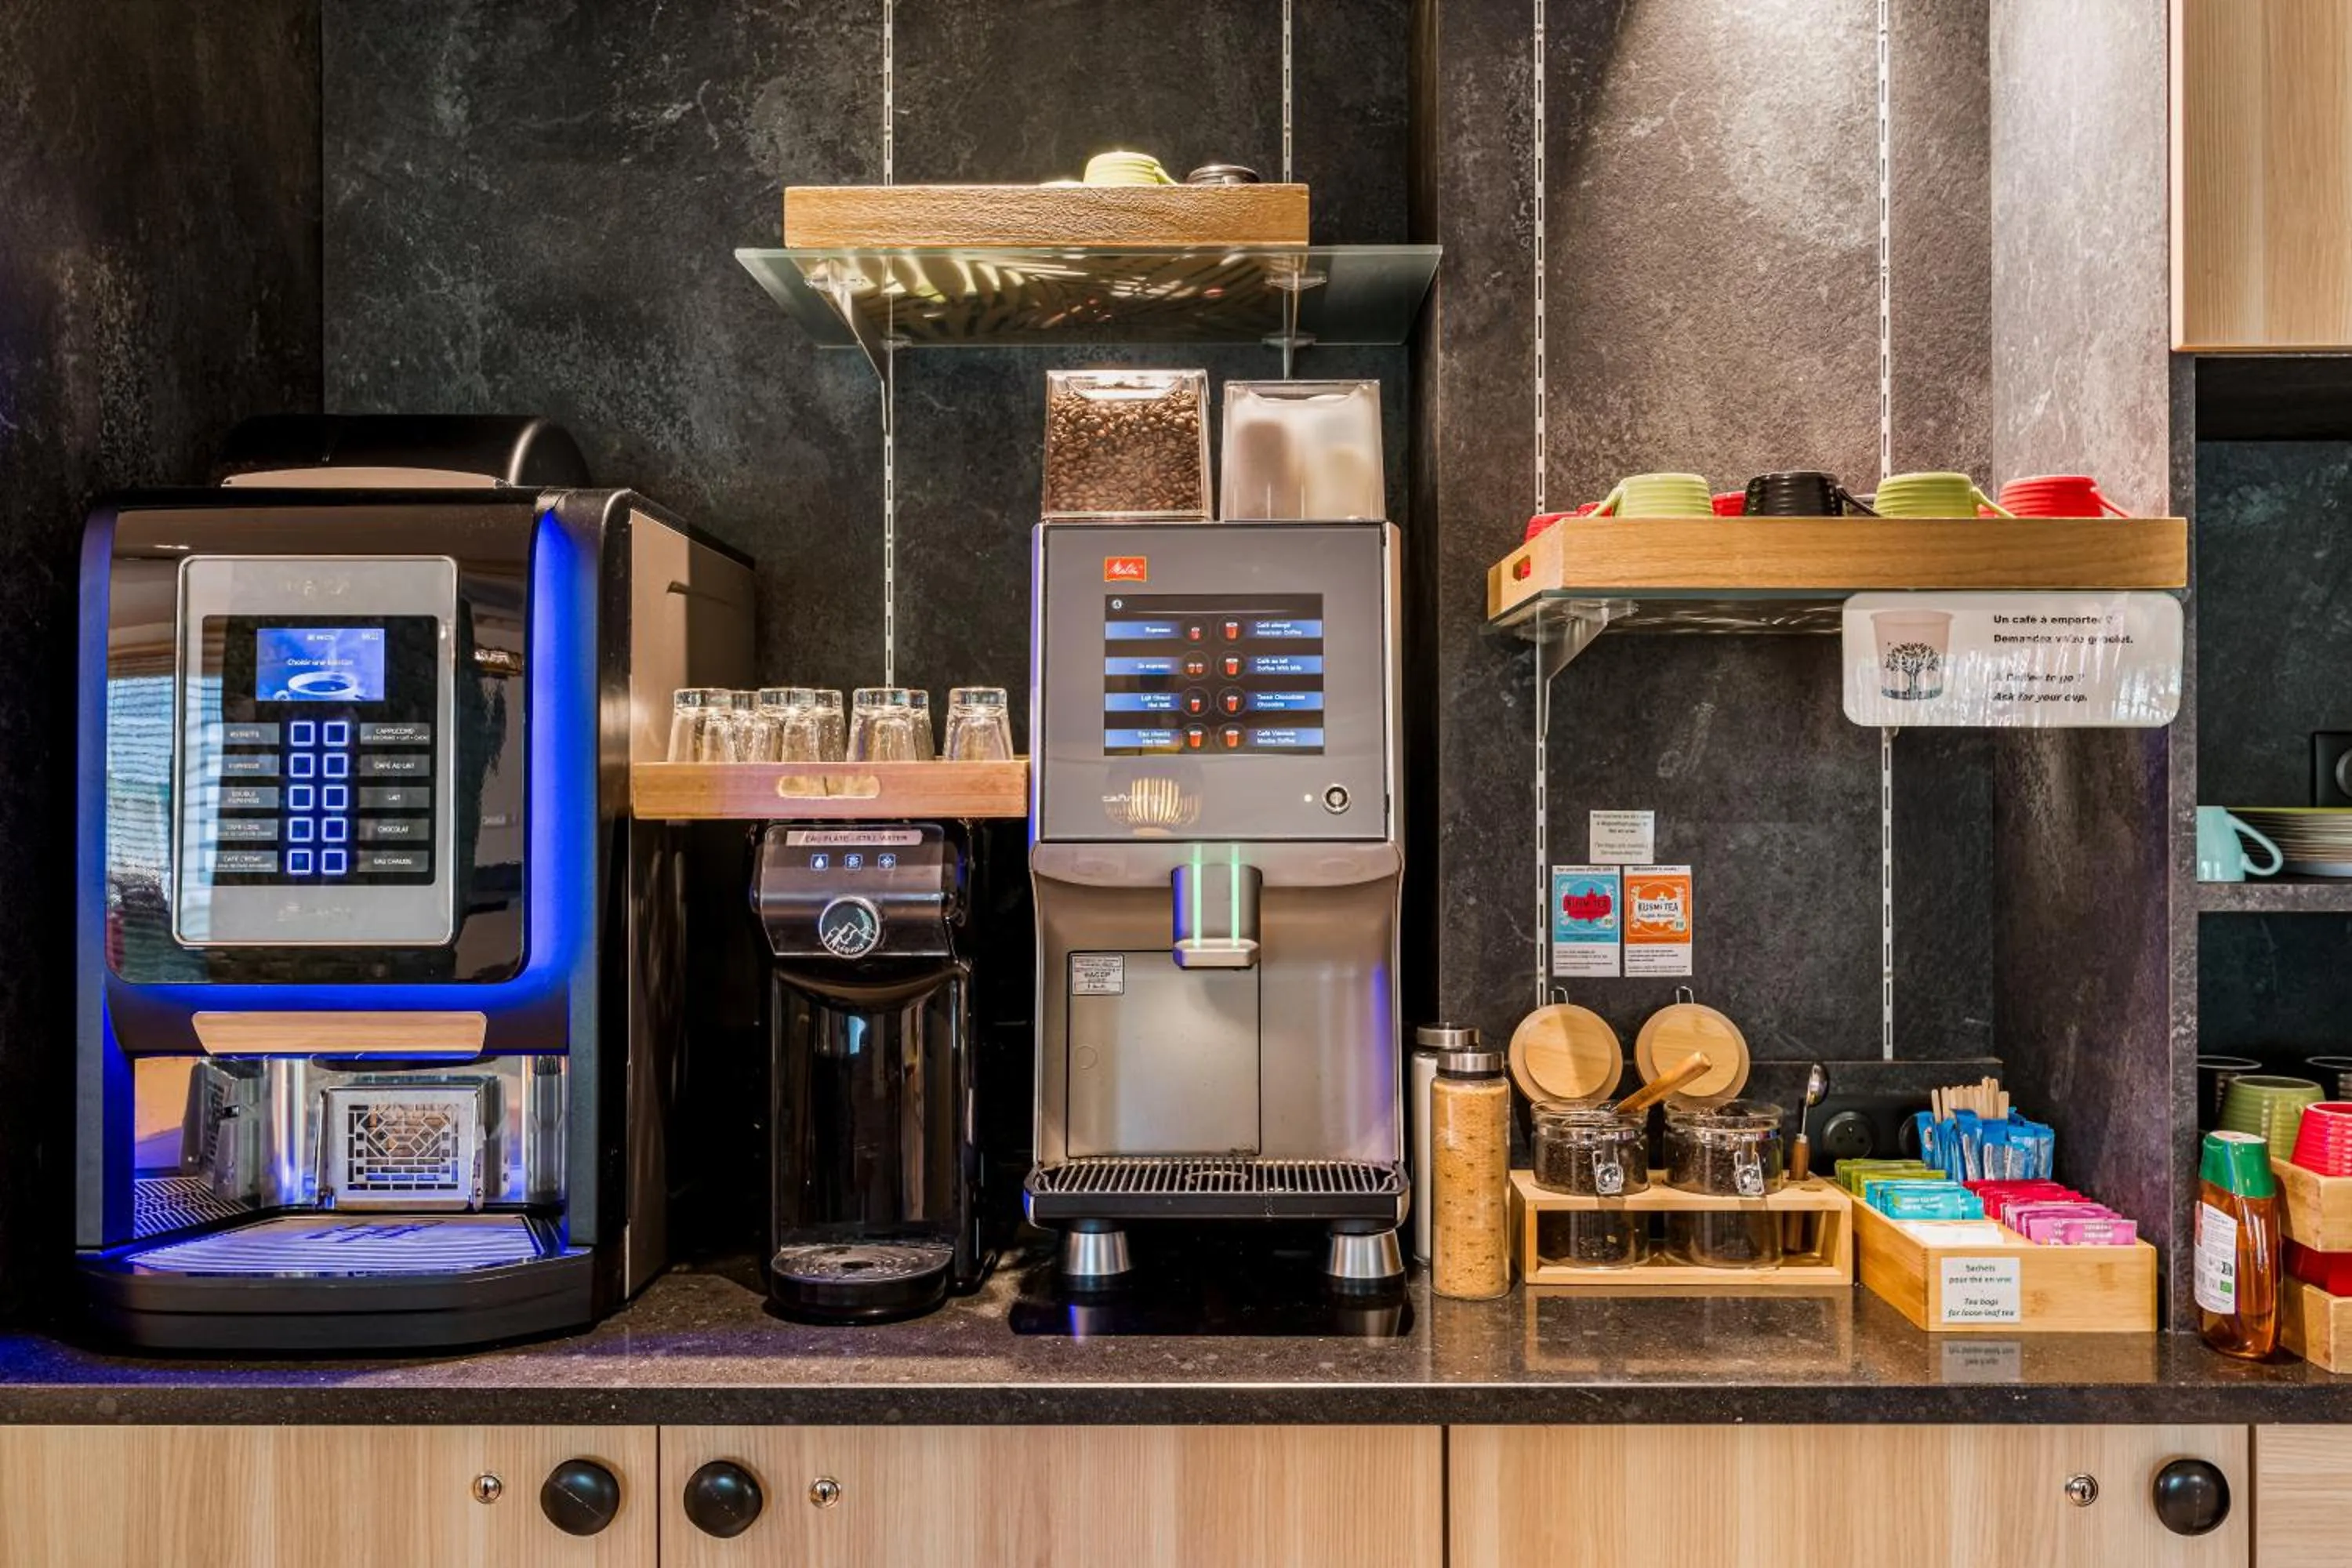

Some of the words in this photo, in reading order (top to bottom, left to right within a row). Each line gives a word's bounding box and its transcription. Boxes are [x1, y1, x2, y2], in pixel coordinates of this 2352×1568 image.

[1994, 615, 2009, 624] Un
[2013, 615, 2037, 624] café
[1992, 692, 2013, 701] Ask
[2017, 692, 2035, 701] for
[2035, 693, 2063, 703] your
[1664, 902, 1679, 912] TEA
[1980, 1298, 1998, 1307] bags
